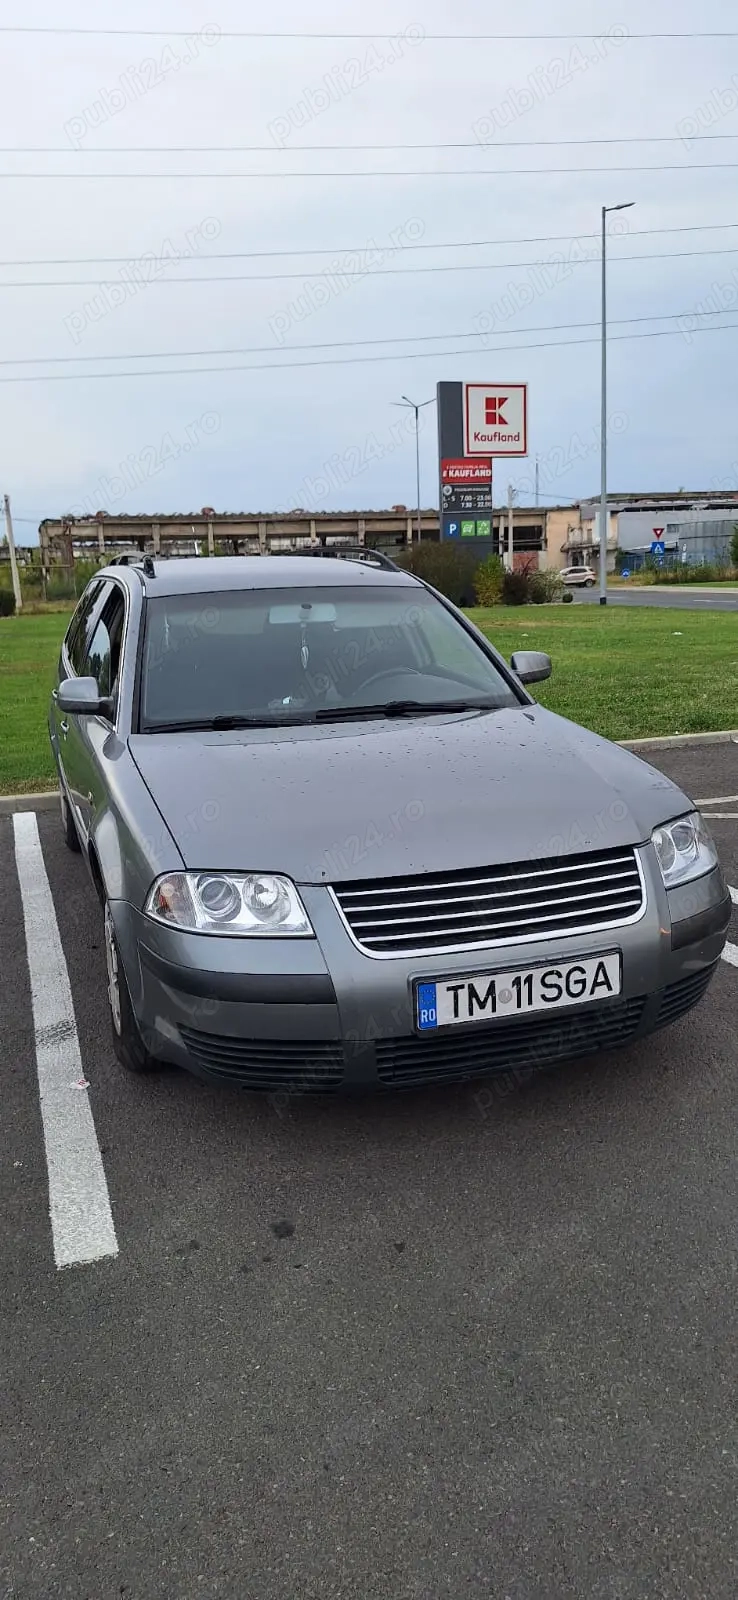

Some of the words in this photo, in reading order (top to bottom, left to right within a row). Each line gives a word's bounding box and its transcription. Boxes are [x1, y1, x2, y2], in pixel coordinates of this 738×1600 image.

[473, 431, 520, 442] Kaufland
[448, 469, 491, 477] KAUFLAND
[446, 980, 497, 1018] TM
[511, 974, 533, 1009] 11
[540, 961, 613, 1003] SGA
[420, 1008, 436, 1023] RO
